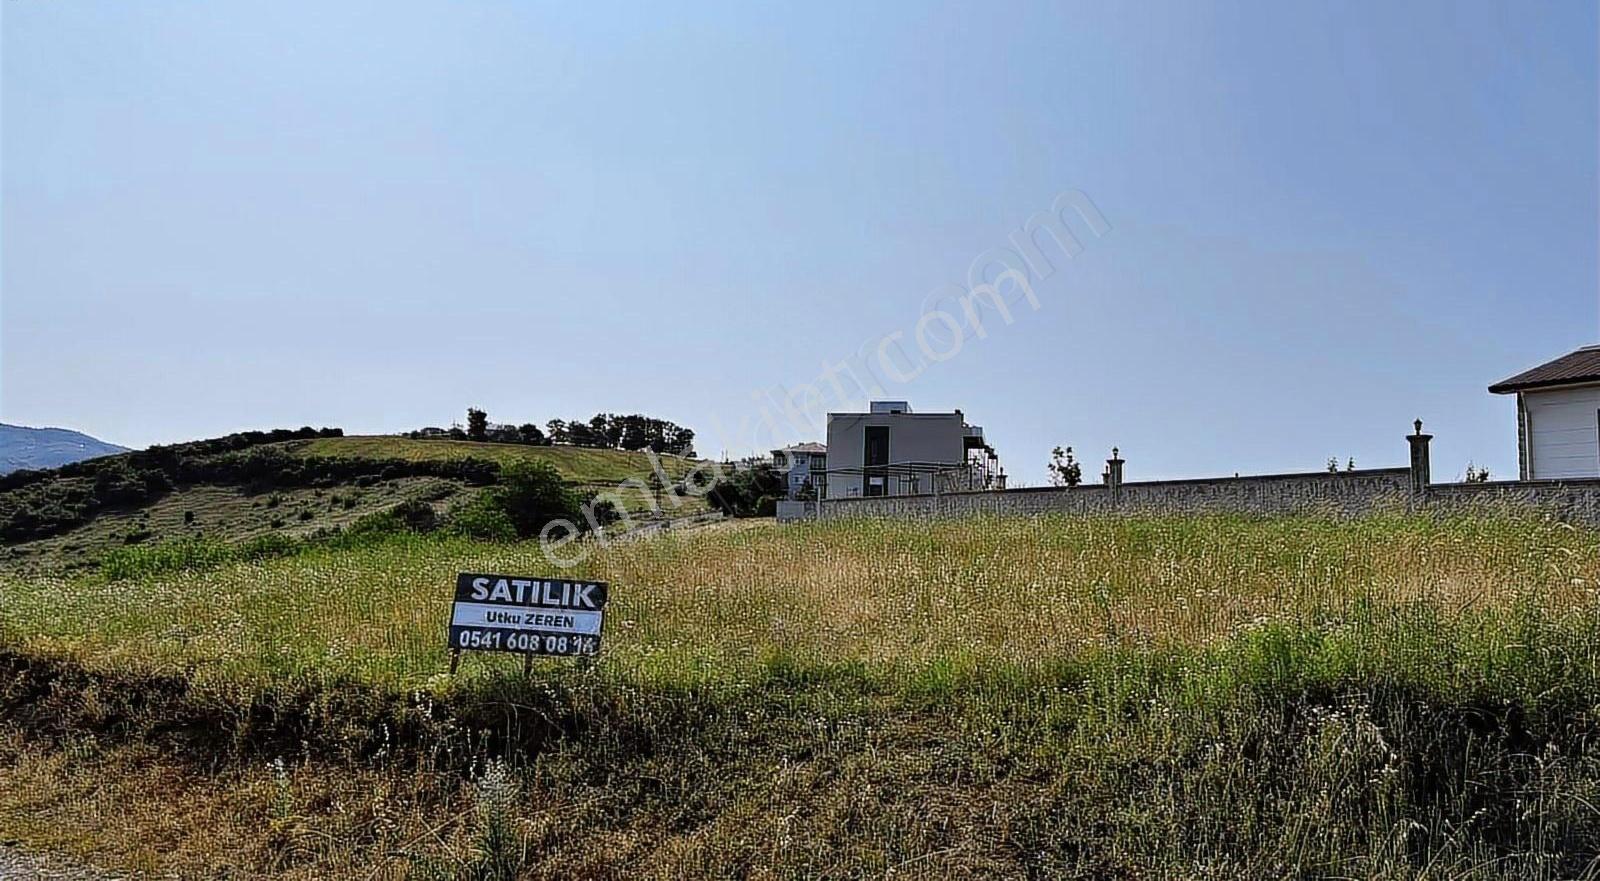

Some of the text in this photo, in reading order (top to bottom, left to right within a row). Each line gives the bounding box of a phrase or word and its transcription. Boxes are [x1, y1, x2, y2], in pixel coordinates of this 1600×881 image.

[471, 577, 598, 608] SATILIK
[486, 611, 575, 628] Utku ZEREN
[459, 630, 501, 649] 0541
[506, 632, 540, 651] 608
[545, 635, 568, 653] 08
